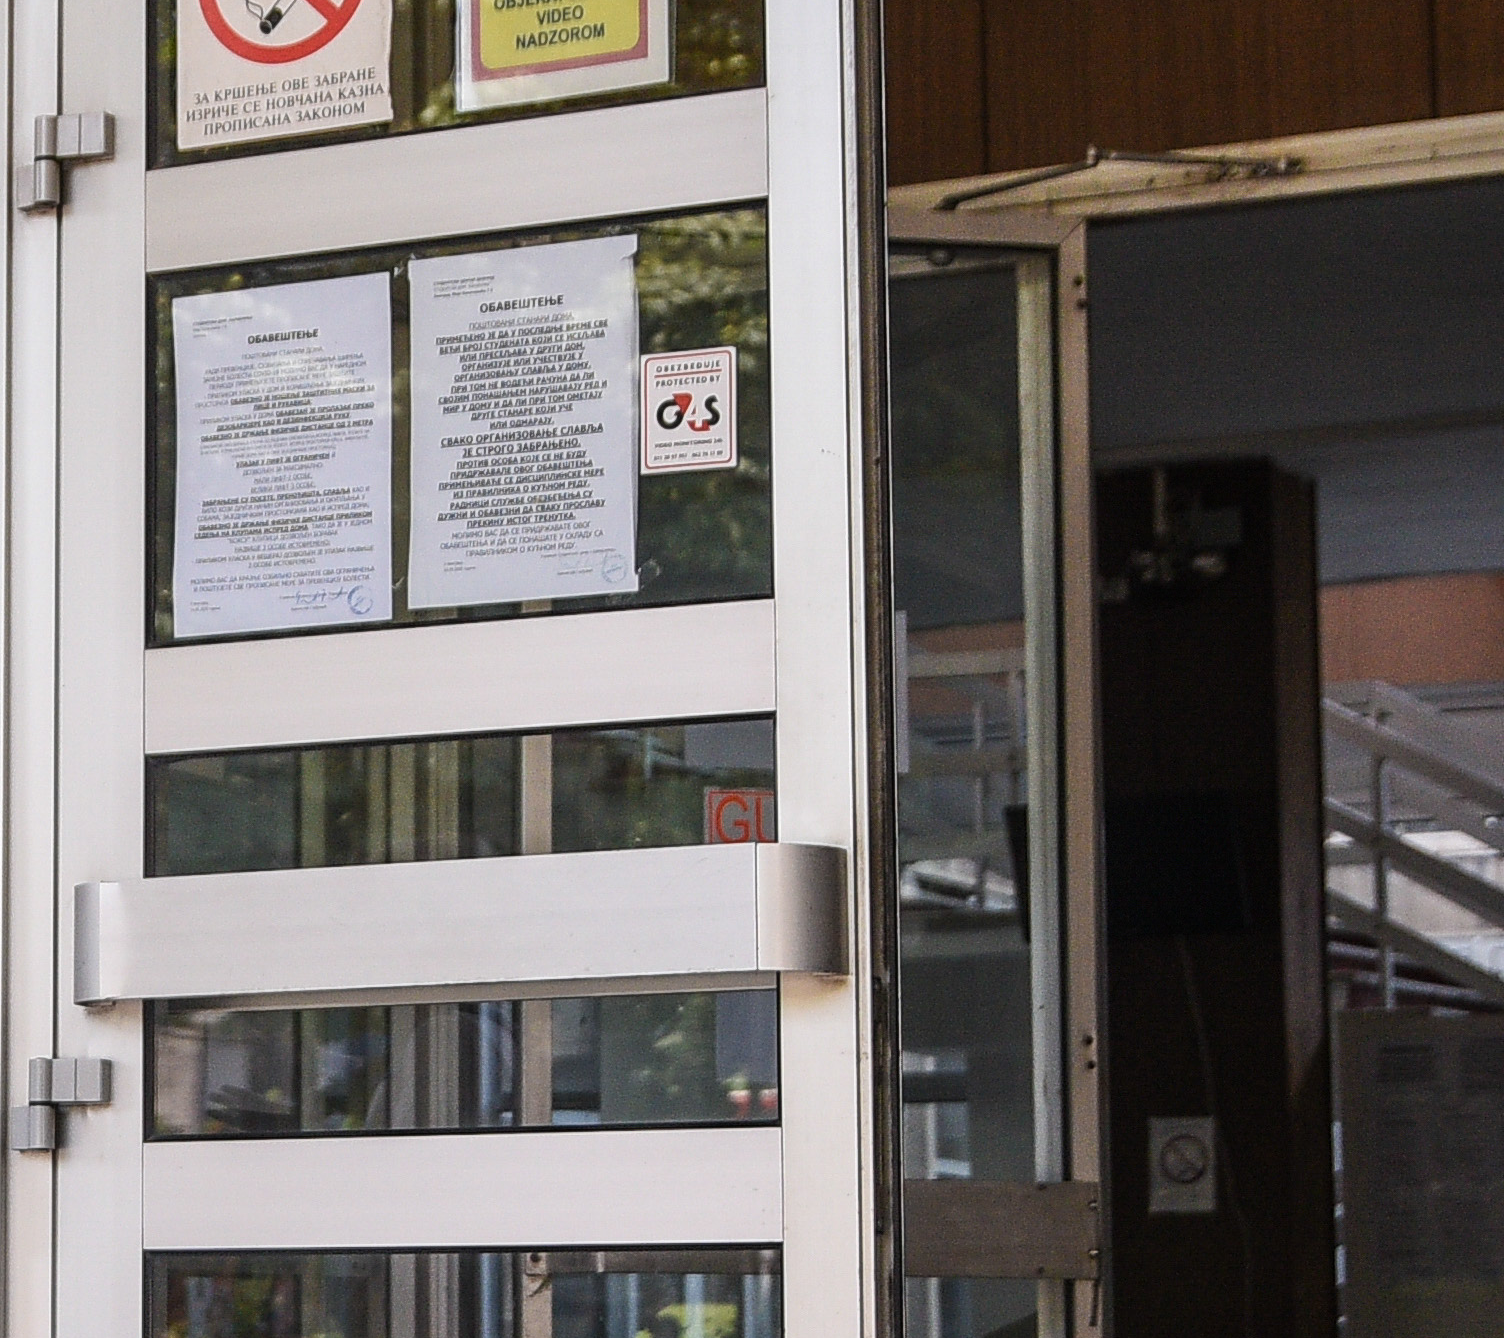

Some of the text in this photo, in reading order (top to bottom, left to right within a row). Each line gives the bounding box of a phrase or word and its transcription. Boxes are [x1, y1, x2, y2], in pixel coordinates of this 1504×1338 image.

[536, 5, 584, 25] VIDEO
[516, 24, 606, 50] NADZOROM
[194, 67, 376, 105] ЗА КРШЕЊЕ ОВЕ ЗАБРАНЕ
[186, 82, 384, 122] ИЗРИЧЕ СЕ НОВЧАНА КАЗНА
[204, 101, 365, 136] ПРОПИСАНА ЗАКОНОМ
[479, 294, 563, 313] ОБАВЕШТЕЊЕ
[247, 327, 318, 345] ОБАВЕШТЕЊЕ
[656, 360, 720, 373] OBEZBEDUJE
[656, 375, 721, 388] PROTECTED BY
[656, 392, 720, 432] G4S
[440, 422, 603, 447] СВАКО ОРГАНИЗОВАЊЕ СЛАВЉА
[462, 447, 472, 458] ЈЕ
[476, 443, 513, 456] СТРОГО
